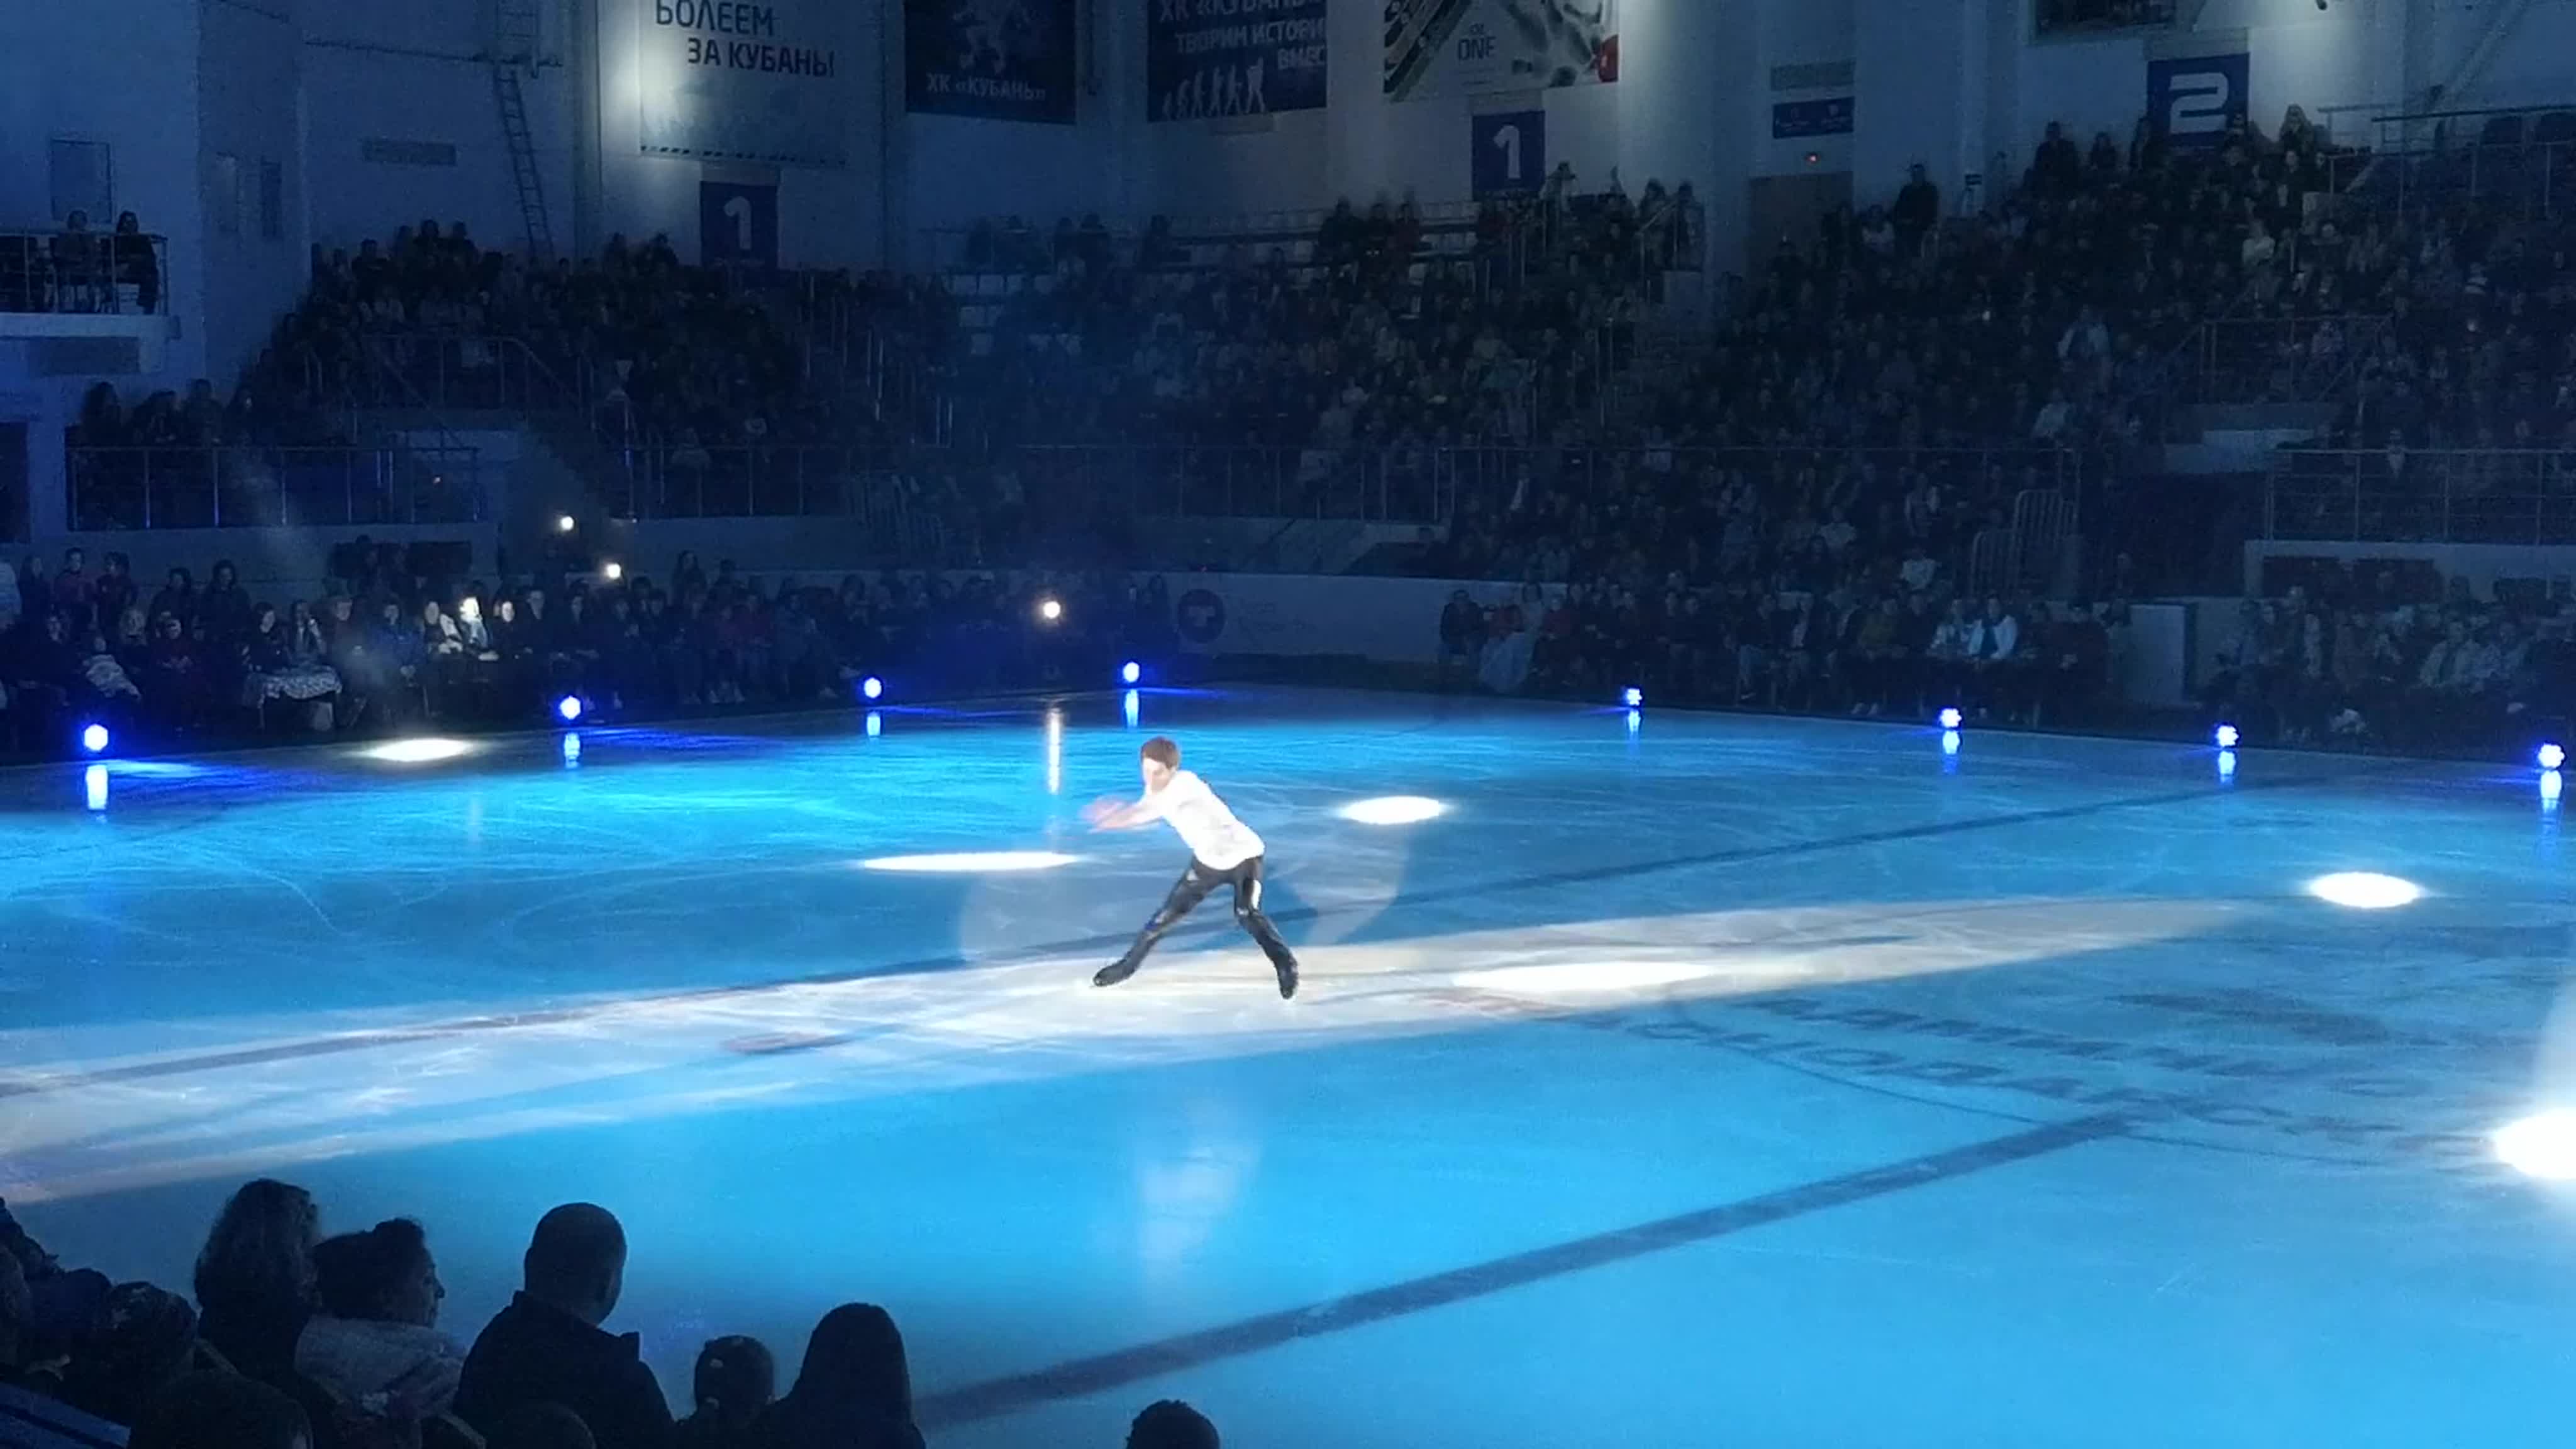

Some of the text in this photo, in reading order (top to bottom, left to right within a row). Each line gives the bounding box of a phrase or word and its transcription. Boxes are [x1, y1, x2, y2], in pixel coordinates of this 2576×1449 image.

[655, 0, 775, 36] БОЛЕЕМ
[1252, 18, 1324, 45] ИСТОРИ
[687, 38, 721, 65] ЗА
[1277, 45, 1325, 70] ВМЕС
[926, 72, 951, 92] ХК
[2170, 72, 2229, 135] 2
[1493, 125, 1521, 180] 1
[724, 196, 752, 251] 1
